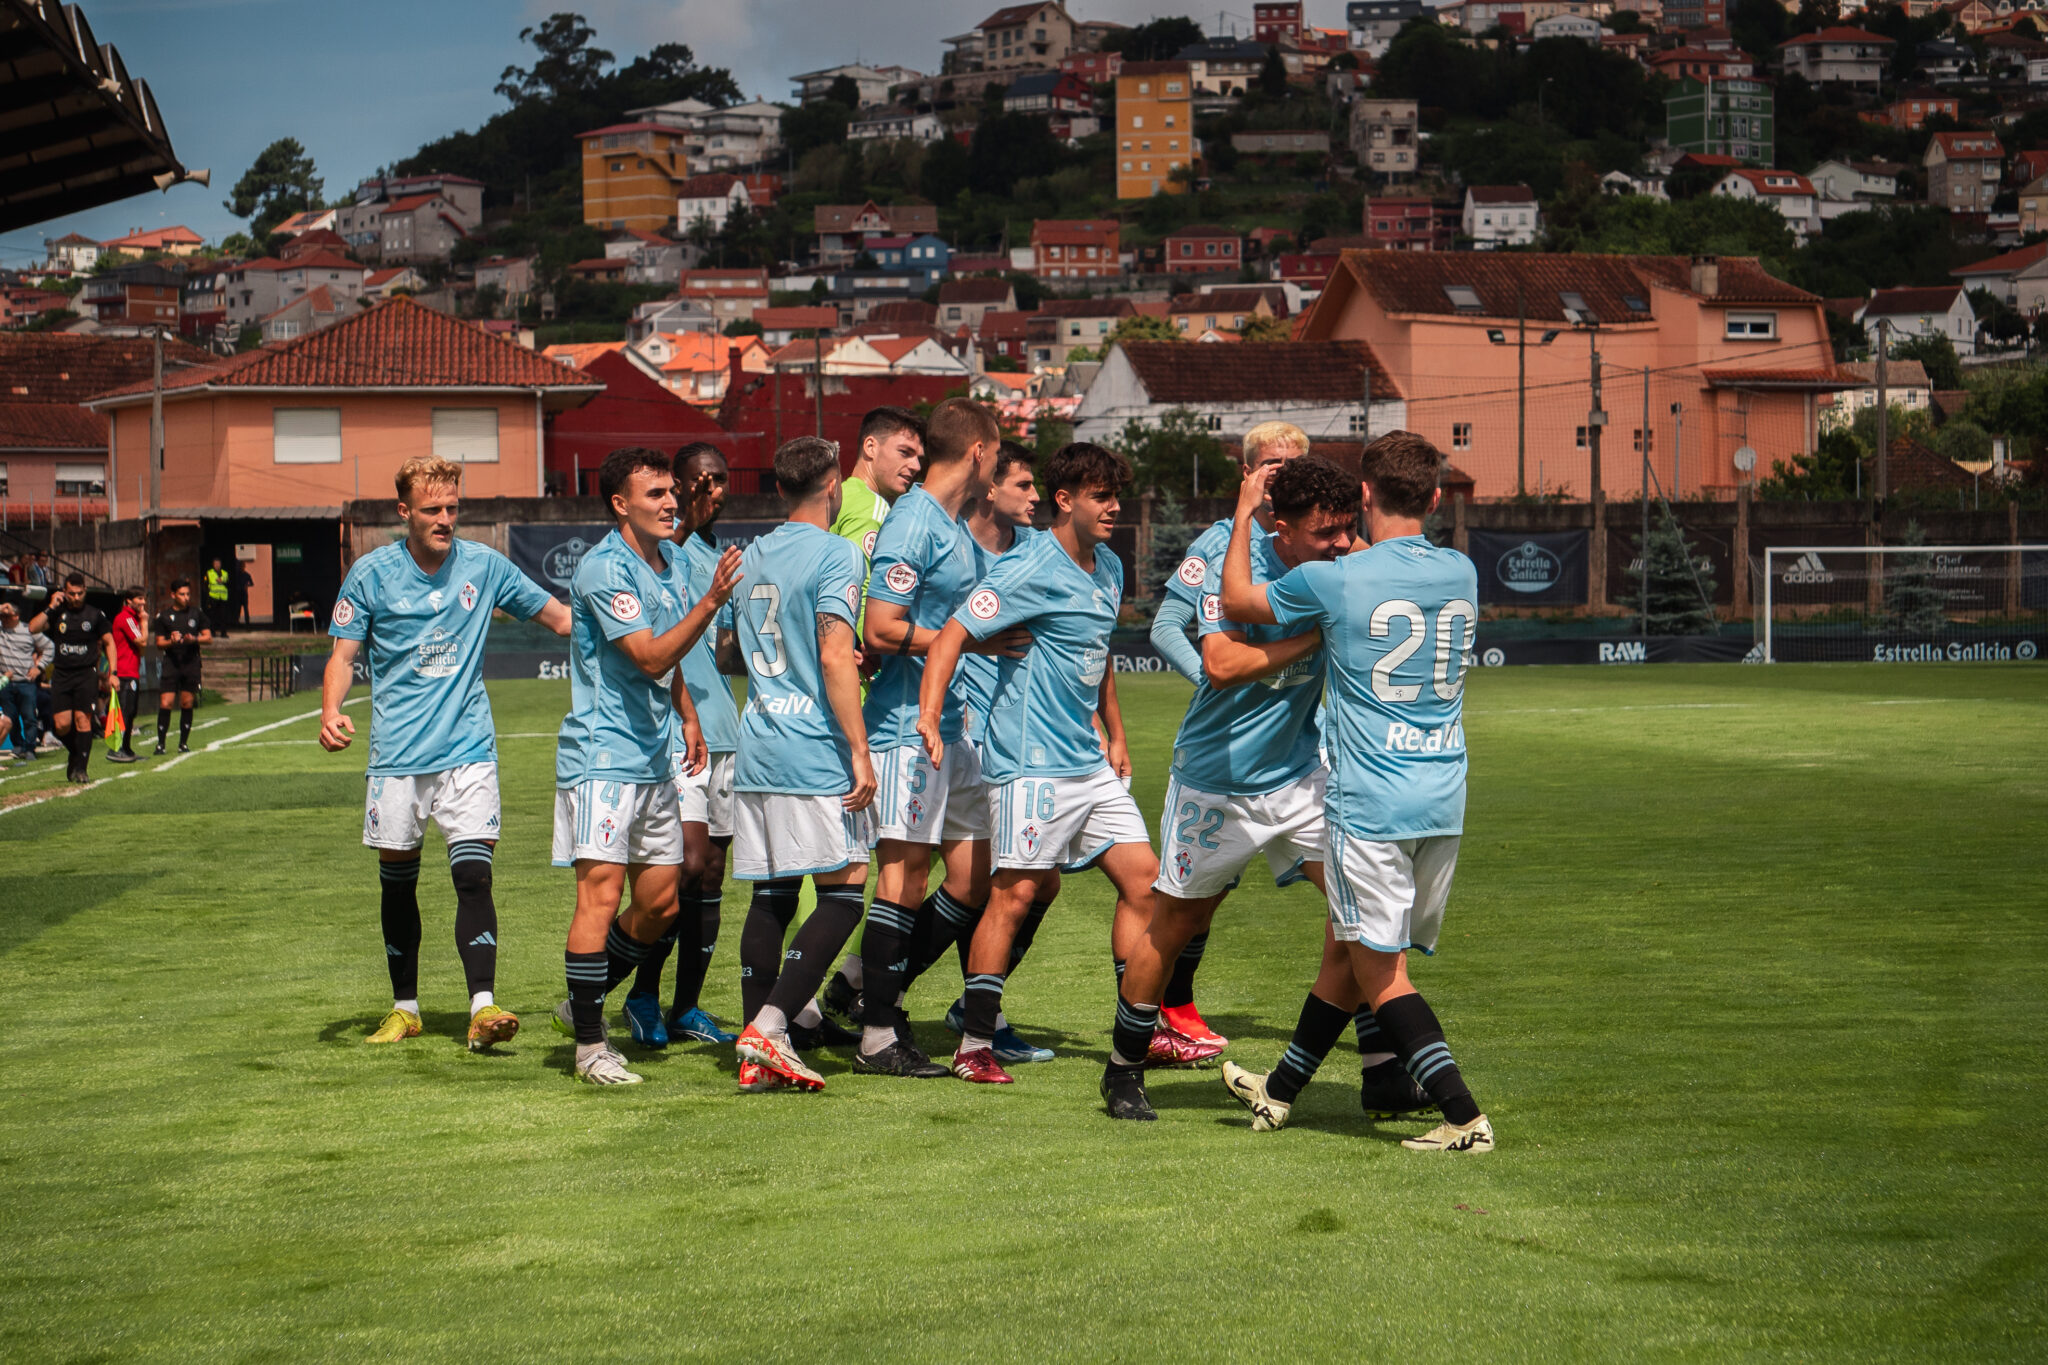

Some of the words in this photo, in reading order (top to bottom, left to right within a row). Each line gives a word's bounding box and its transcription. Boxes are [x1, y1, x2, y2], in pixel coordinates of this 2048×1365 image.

[1508, 556, 1550, 569] Estrella
[1509, 568, 1548, 580] Galicia
[1783, 571, 1833, 583] adidas
[749, 584, 788, 678] 3
[418, 643, 458, 655] Estrella
[1369, 599, 1476, 702] 20
[1599, 641, 1646, 661] RAW
[1873, 643, 1942, 662] Estrella
[1946, 642, 2011, 661] Galicia
[420, 653, 457, 666] Galicia
[1112, 655, 1160, 672] FARO
[906, 756, 927, 794] 5
[600, 781, 620, 810] 4
[1022, 781, 1055, 821] 16
[1176, 801, 1225, 849] 22
